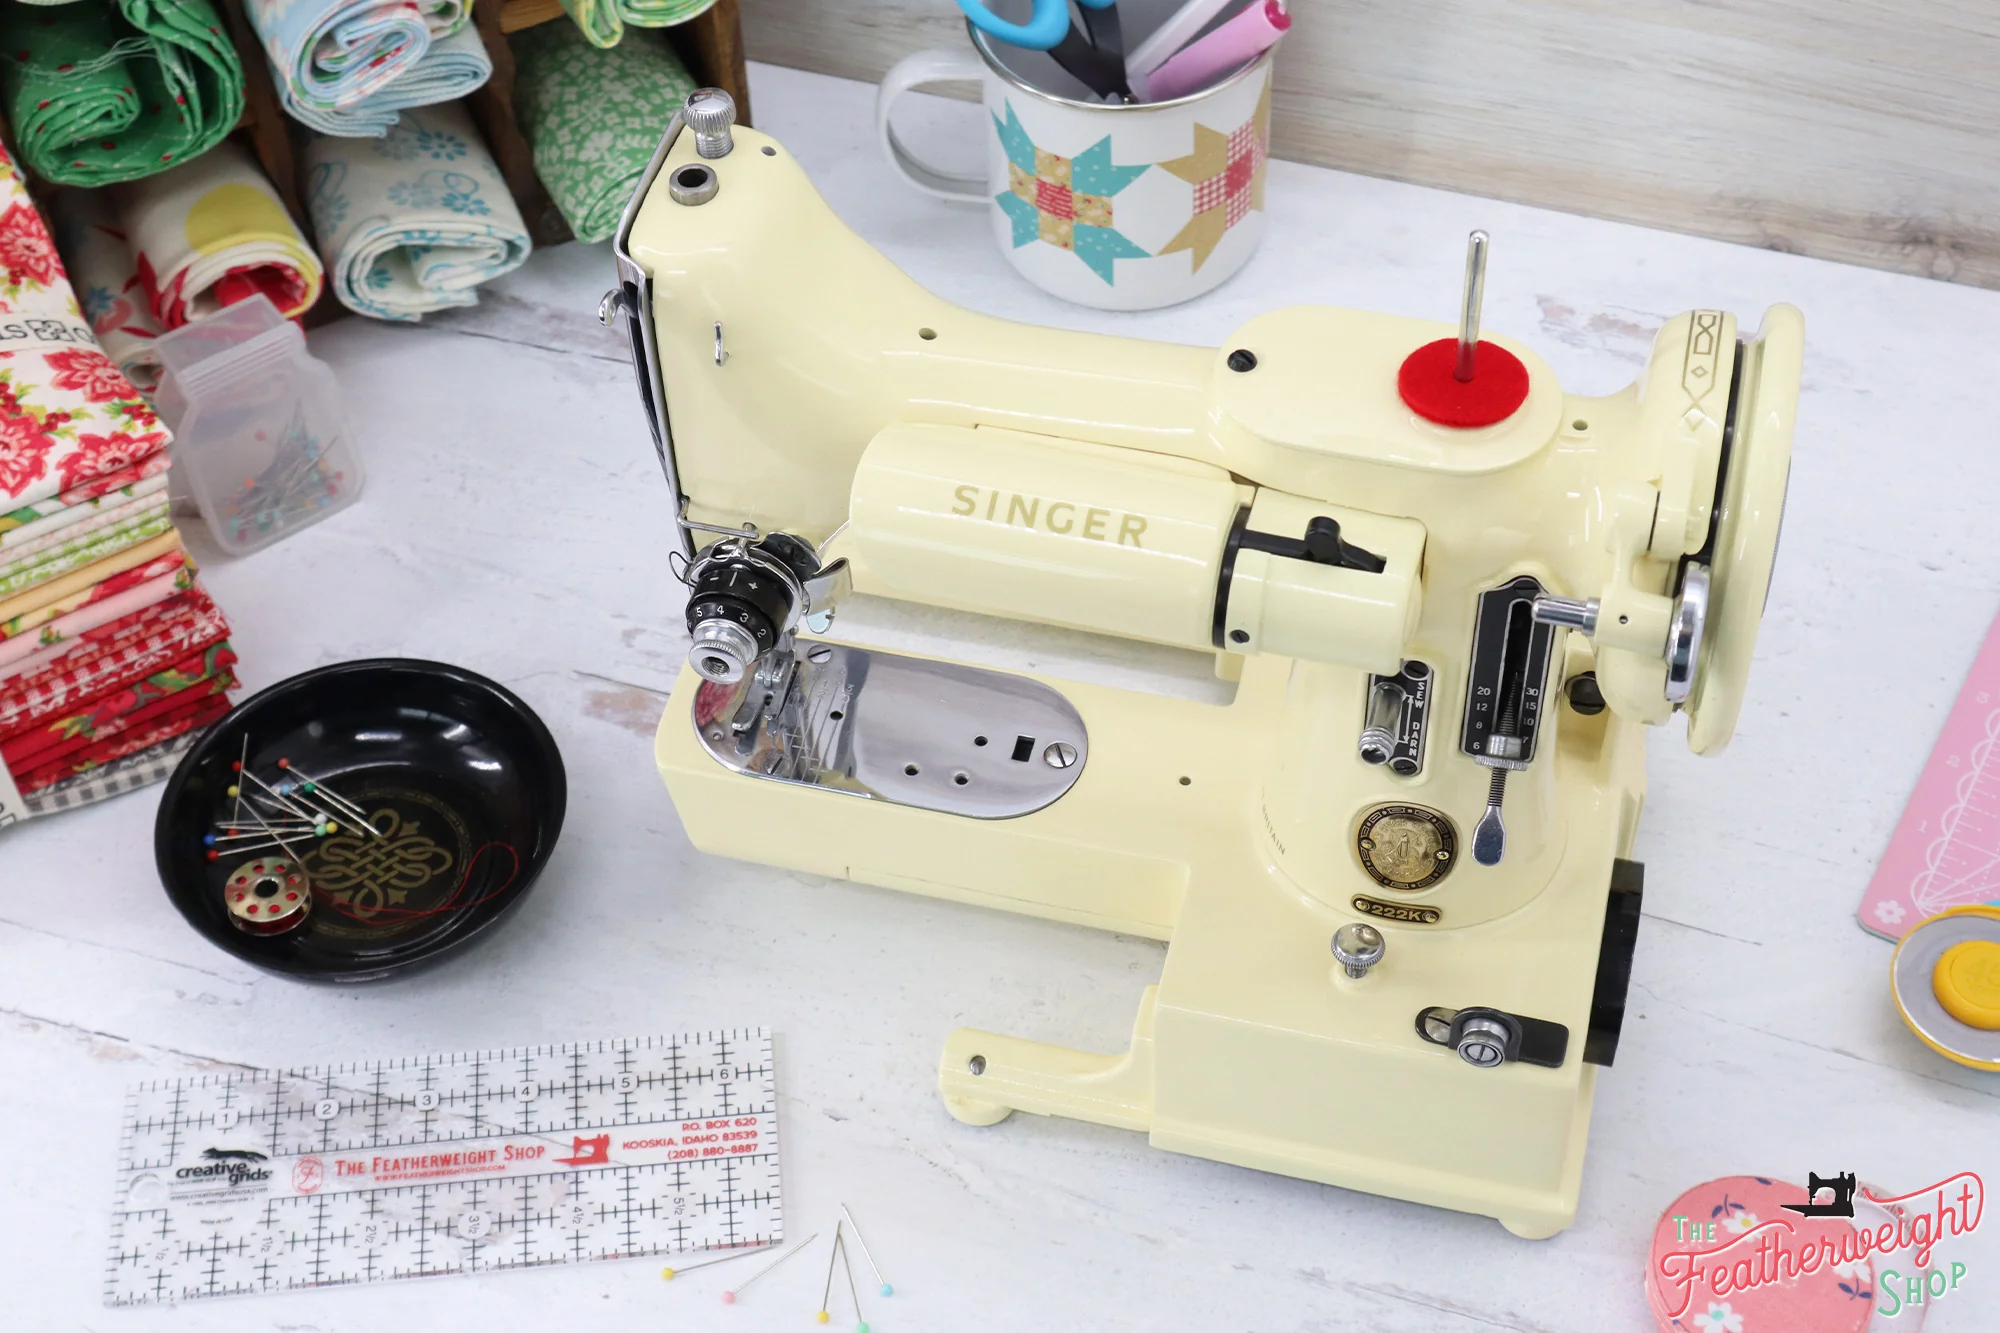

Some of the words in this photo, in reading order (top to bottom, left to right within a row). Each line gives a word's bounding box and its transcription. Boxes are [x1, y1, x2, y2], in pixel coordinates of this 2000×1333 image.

[951, 484, 1149, 549] SINGER
[696, 606, 703, 617] 5
[717, 605, 724, 615] 4
[739, 613, 749, 623] 3
[757, 628, 767, 639] 2
[1414, 682, 1425, 708] SEW
[1476, 686, 1491, 696] 20
[1525, 688, 1539, 696] 30
[1476, 703, 1488, 711] 12
[1525, 702, 1537, 710] 15
[1408, 722, 1421, 757] DARN
[1473, 742, 1480, 750] 6
[1371, 904, 1422, 921] 222K
[720, 1069, 729, 1079] 6
[621, 1078, 630, 1088] 5
[521, 1086, 531, 1097] 4
[422, 1095, 431, 1105] 3
[322, 1104, 331, 1115] 2
[223, 1113, 229, 1123] 1
[706, 1119, 731, 1129] BOX
[734, 1117, 757, 1127] 620
[682, 1133, 719, 1144] IDAHO
[722, 1131, 758, 1141] 83539
[668, 1148, 698, 1160] (208)
[703, 1143, 759, 1155] 880-8887
[335, 1160, 365, 1176] THE
[372, 1149, 497, 1173] FEATHERWEIGHT
[504, 1145, 546, 1161] SHOP
[176, 1160, 247, 1179] creative
[228, 1167, 272, 1186] grids
